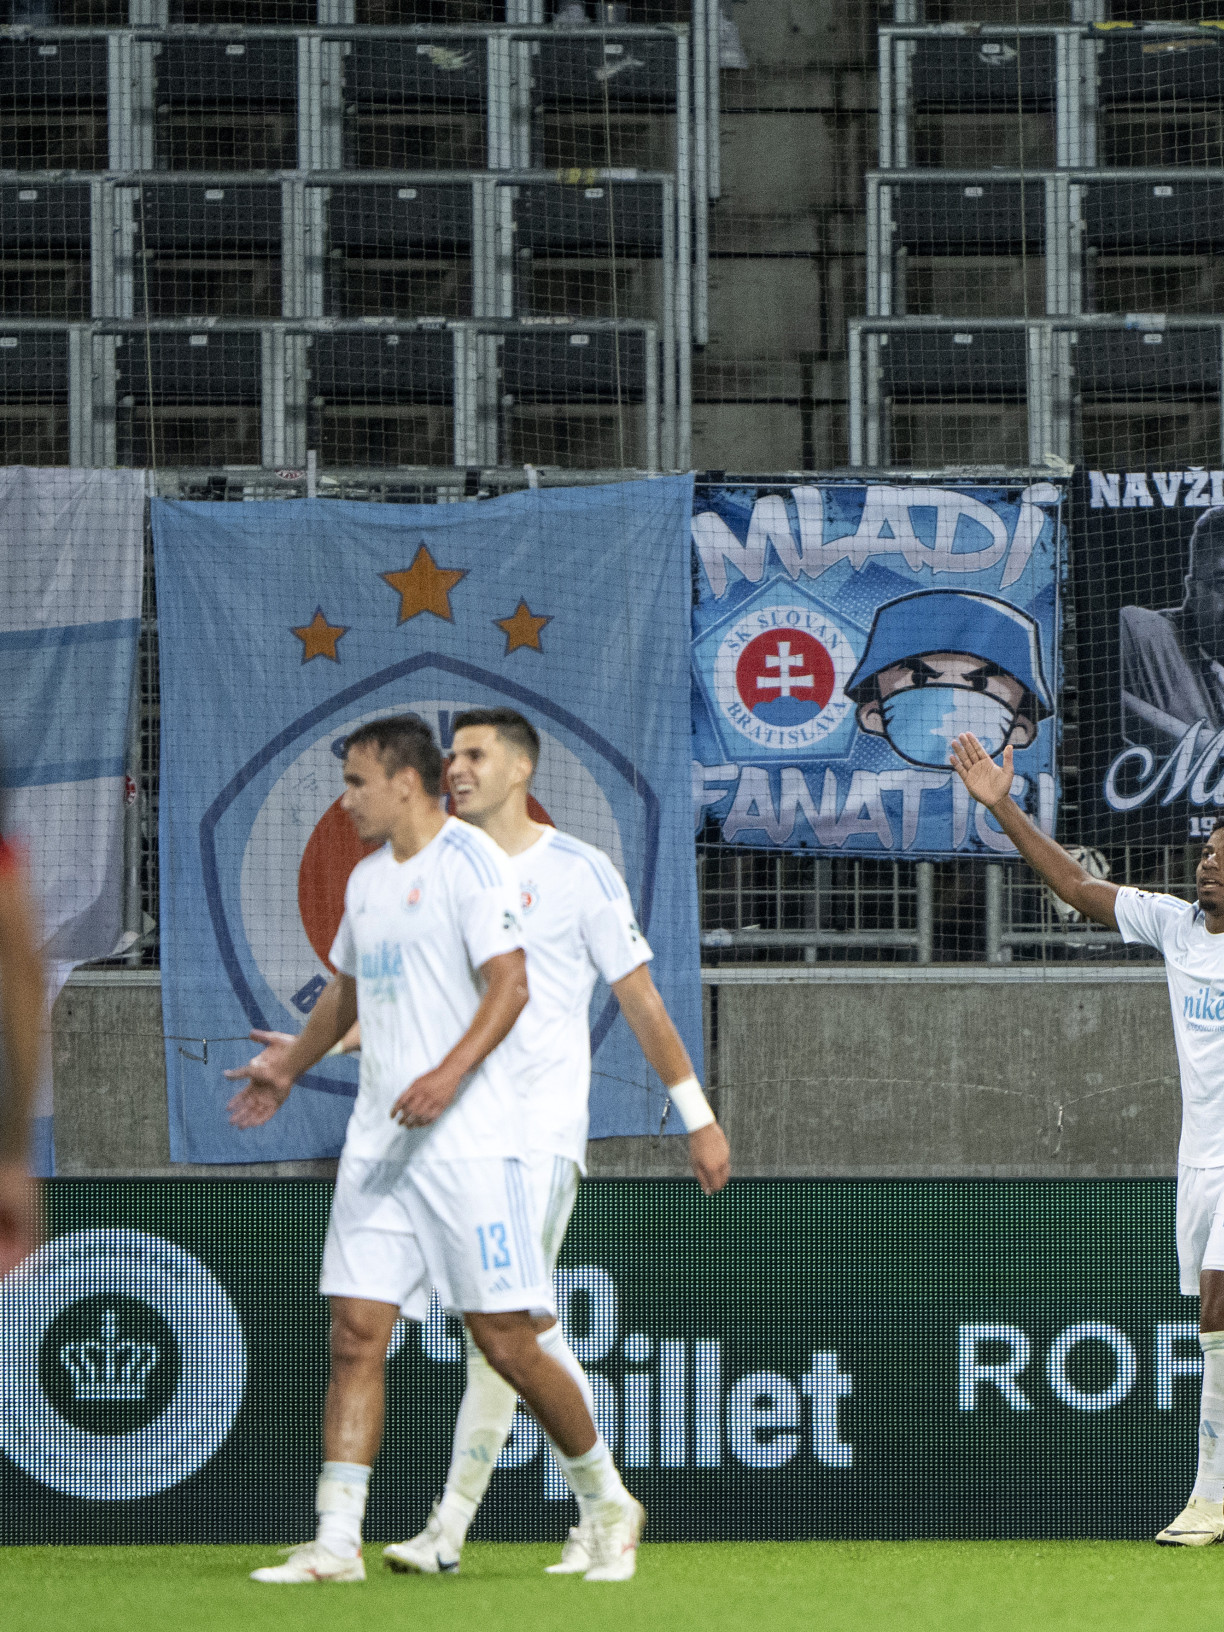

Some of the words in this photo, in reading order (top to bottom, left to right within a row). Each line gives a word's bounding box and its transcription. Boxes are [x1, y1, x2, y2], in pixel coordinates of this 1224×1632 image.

[757, 610, 840, 651] SLOVAN
[727, 701, 847, 745] BRATISLAVA
[476, 1221, 512, 1272] 13
